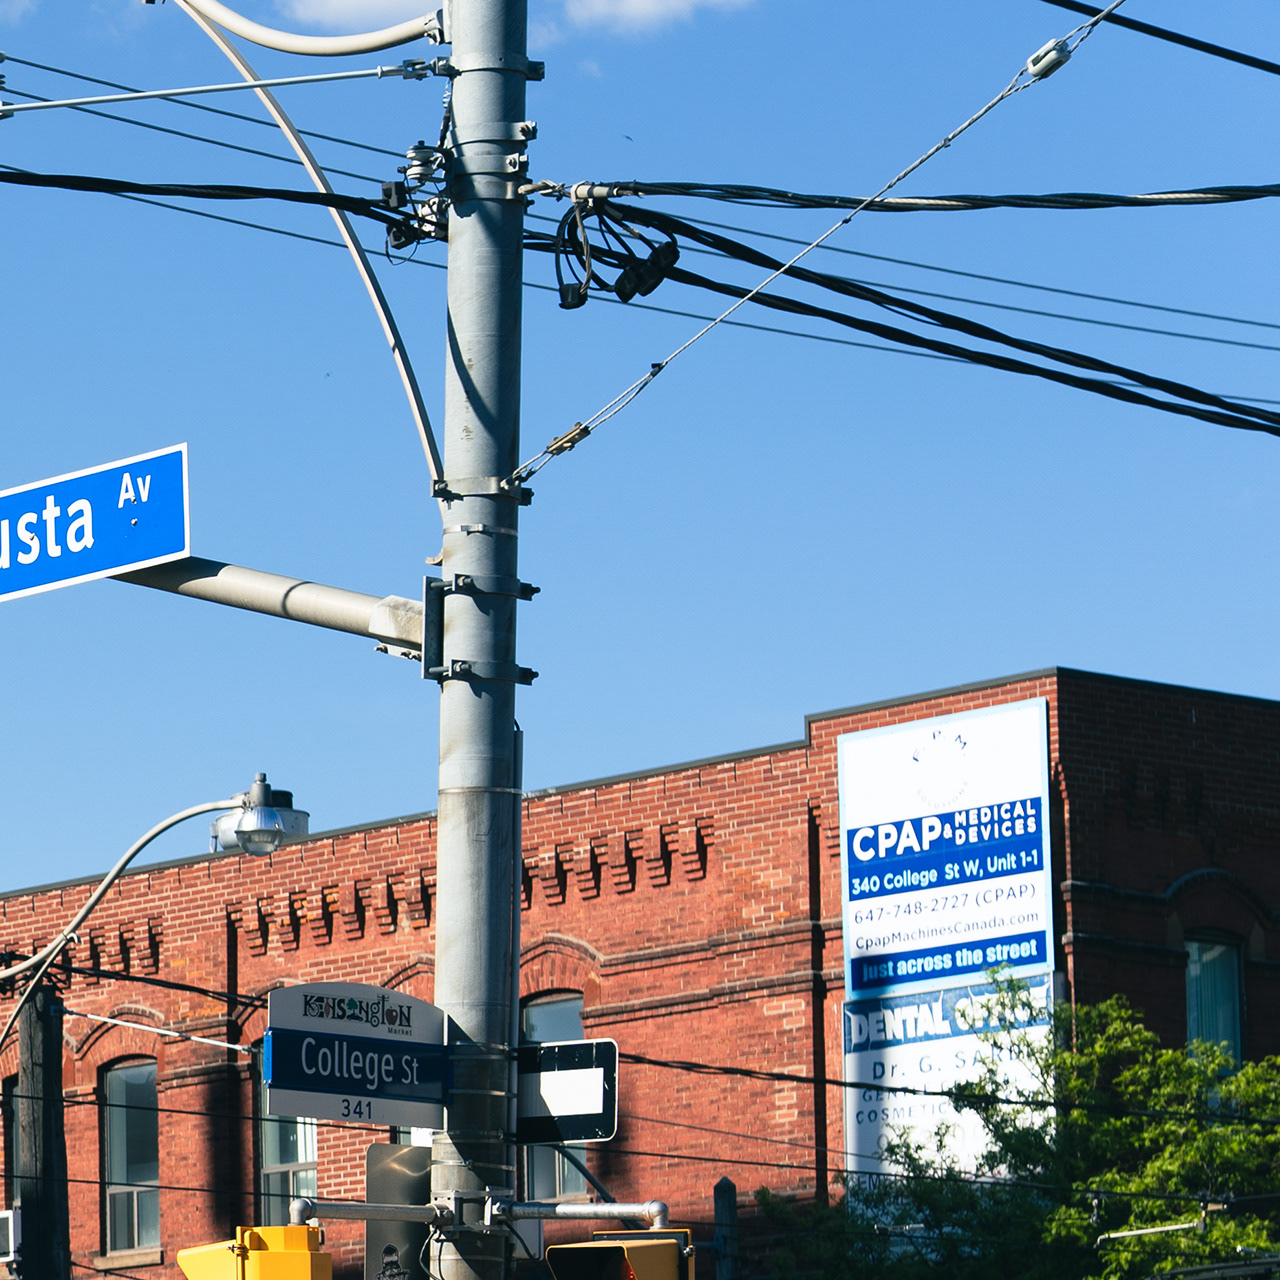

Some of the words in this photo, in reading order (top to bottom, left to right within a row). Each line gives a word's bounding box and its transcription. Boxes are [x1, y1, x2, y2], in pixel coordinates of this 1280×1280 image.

[118, 472, 152, 508] Av
[954, 799, 1037, 827] MEDICAL
[955, 817, 1037, 845] DEVICES
[852, 816, 942, 861] CPAP
[943, 823, 953, 839] &
[852, 876, 880, 895] 340
[884, 868, 938, 890] College
[945, 864, 960, 880] St
[963, 859, 984, 877] W,
[987, 855, 1017, 872] Unit
[1020, 849, 1038, 867] 1-1
[855, 894, 969, 924] 647-748-2727
[976, 883, 1037, 907] (CPAP)
[856, 912, 1039, 950] CpapMachinesCanada.com
[863, 961, 894, 982] just
[897, 953, 952, 975] across
[956, 948, 983, 966] the
[986, 939, 1038, 962] street
[388, 1027, 413, 1037] Market
[849, 995, 952, 1048] DENTAL
[301, 1036, 394, 1091] College
[401, 1055, 419, 1086] St
[873, 1061, 905, 1080] Dr.
[919, 1055, 941, 1074] G.
[341, 1099, 373, 1120] 341
